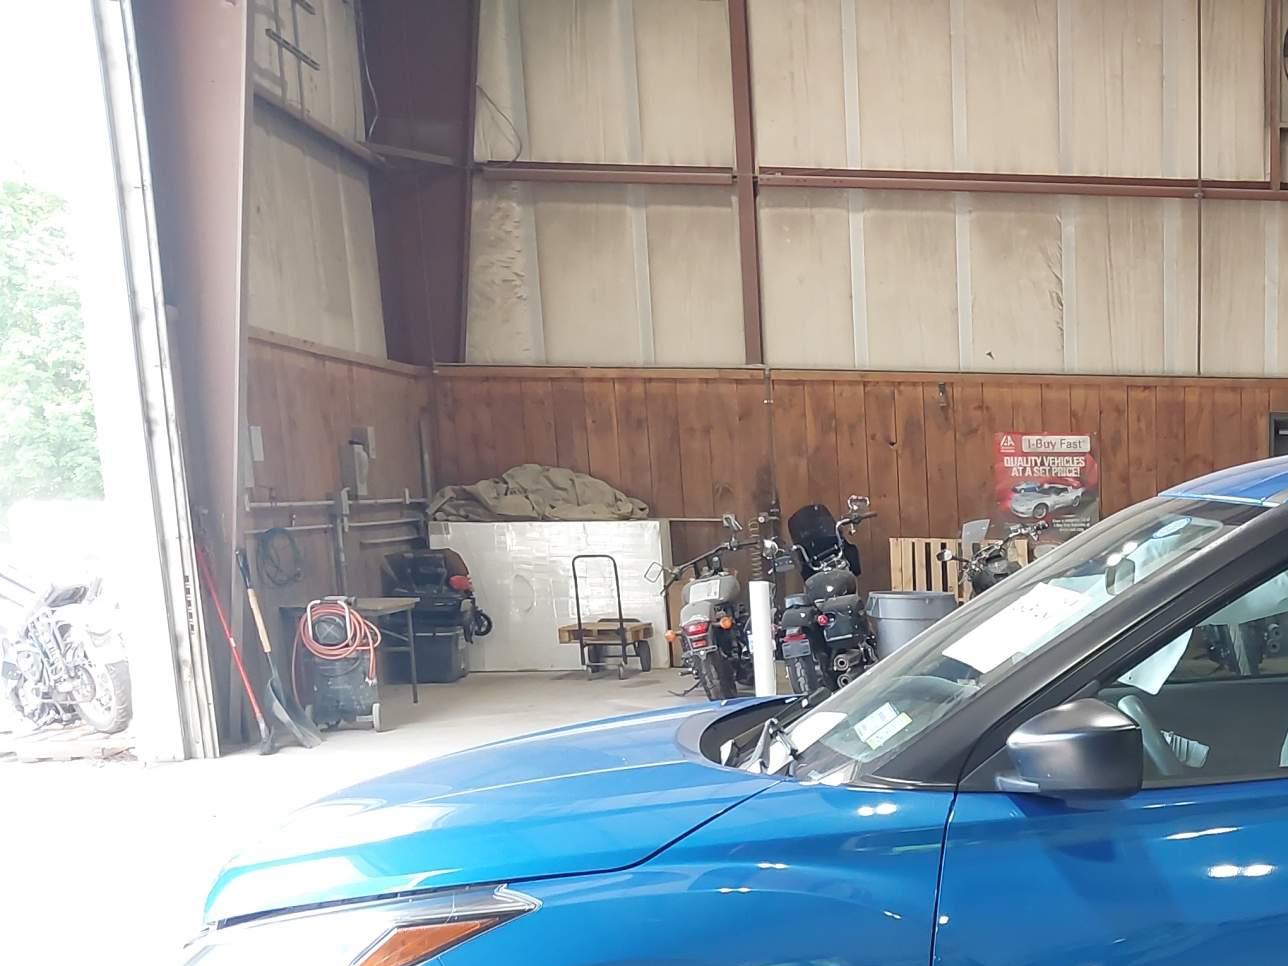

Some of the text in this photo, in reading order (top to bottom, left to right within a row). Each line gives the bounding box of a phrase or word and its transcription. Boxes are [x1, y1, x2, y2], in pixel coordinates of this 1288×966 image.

[1028, 439, 1056, 450] I-Buy
[1060, 439, 1083, 449] Fast
[1004, 456, 1085, 467] QUALITY VEHICLES
[1011, 467, 1080, 477] AT A SET PRICE!
